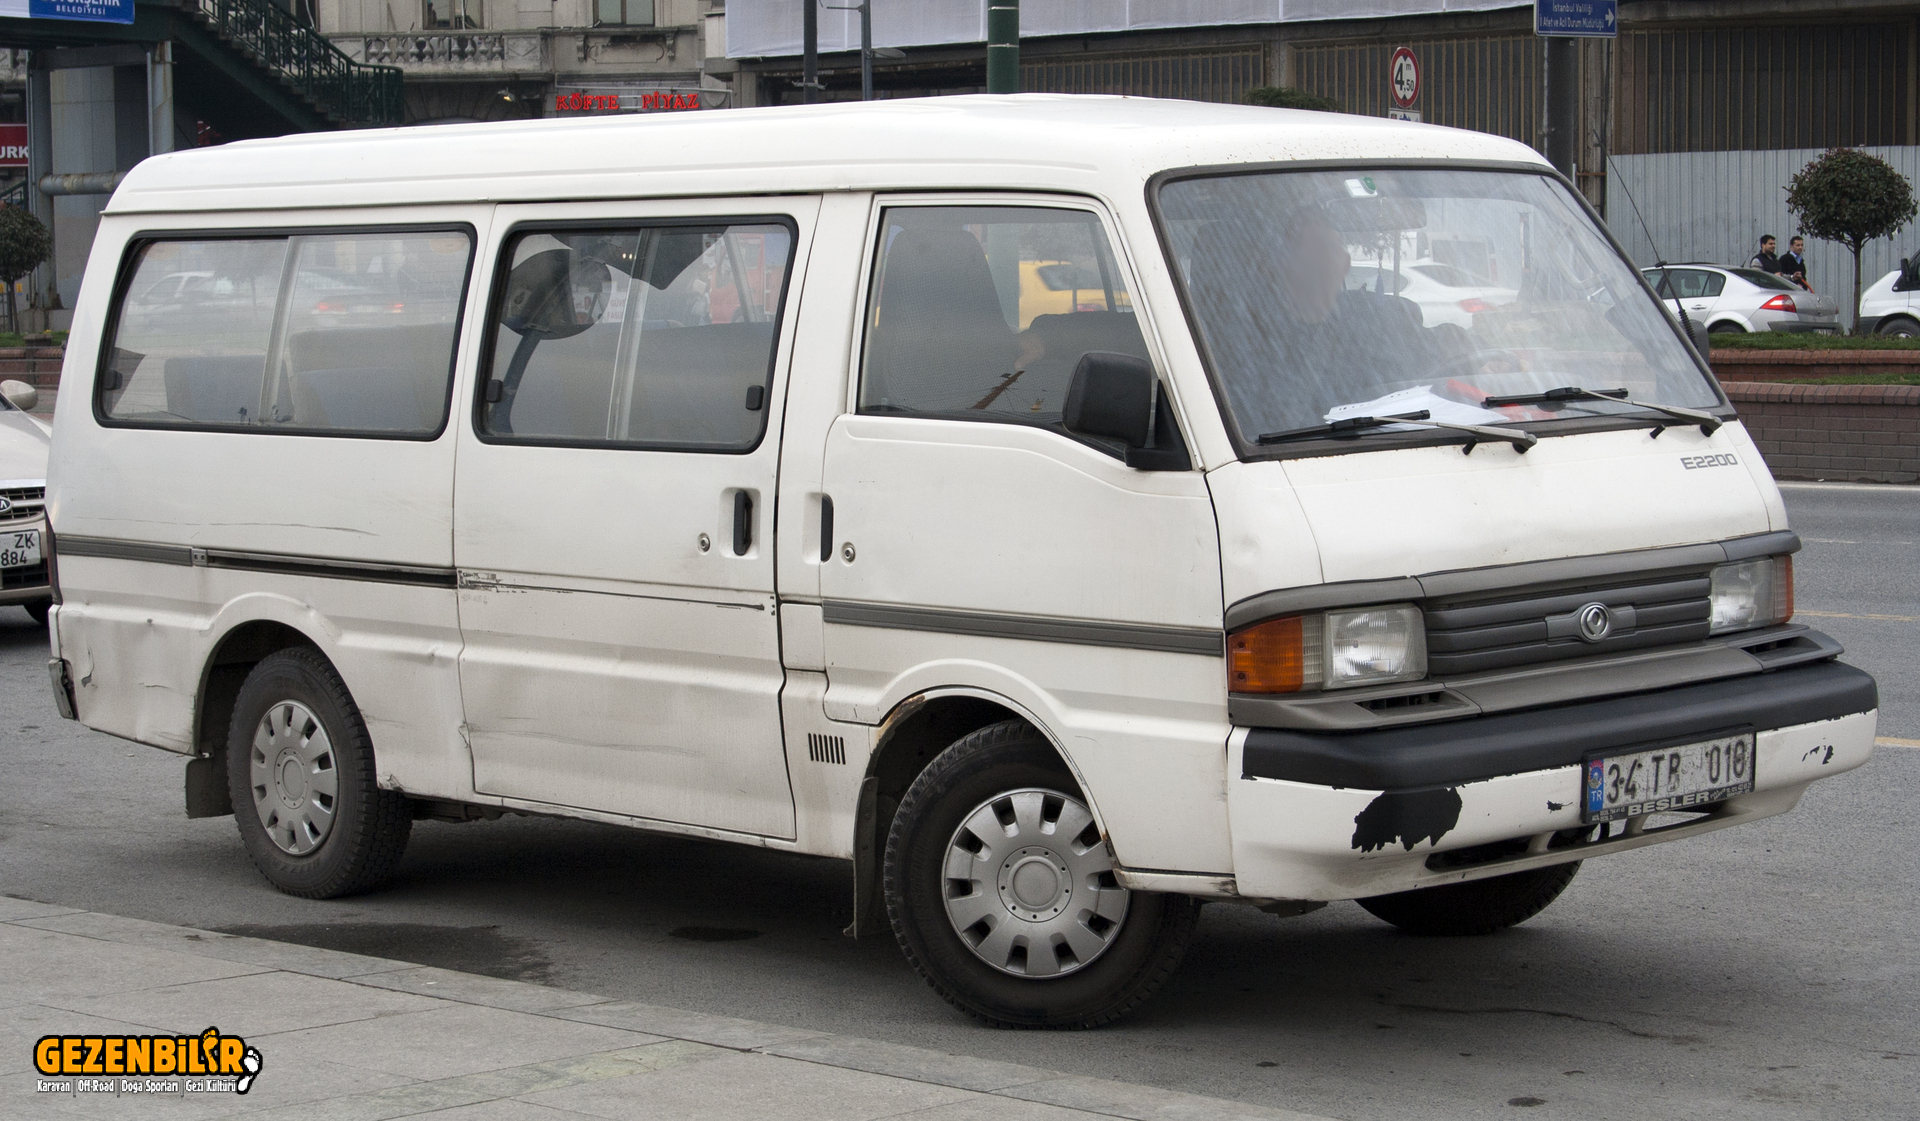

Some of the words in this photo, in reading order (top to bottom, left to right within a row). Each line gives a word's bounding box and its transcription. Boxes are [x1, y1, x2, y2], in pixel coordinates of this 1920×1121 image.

[56, 4, 106, 15] BELEDİYESİ
[556, 93, 619, 110] KÖFTE
[641, 91, 699, 109] PİYAZ
[1680, 453, 1738, 470] E2200
[14, 532, 35, 549] ZK
[1607, 759, 1637, 803] 34
[1591, 789, 1603, 803] TR
